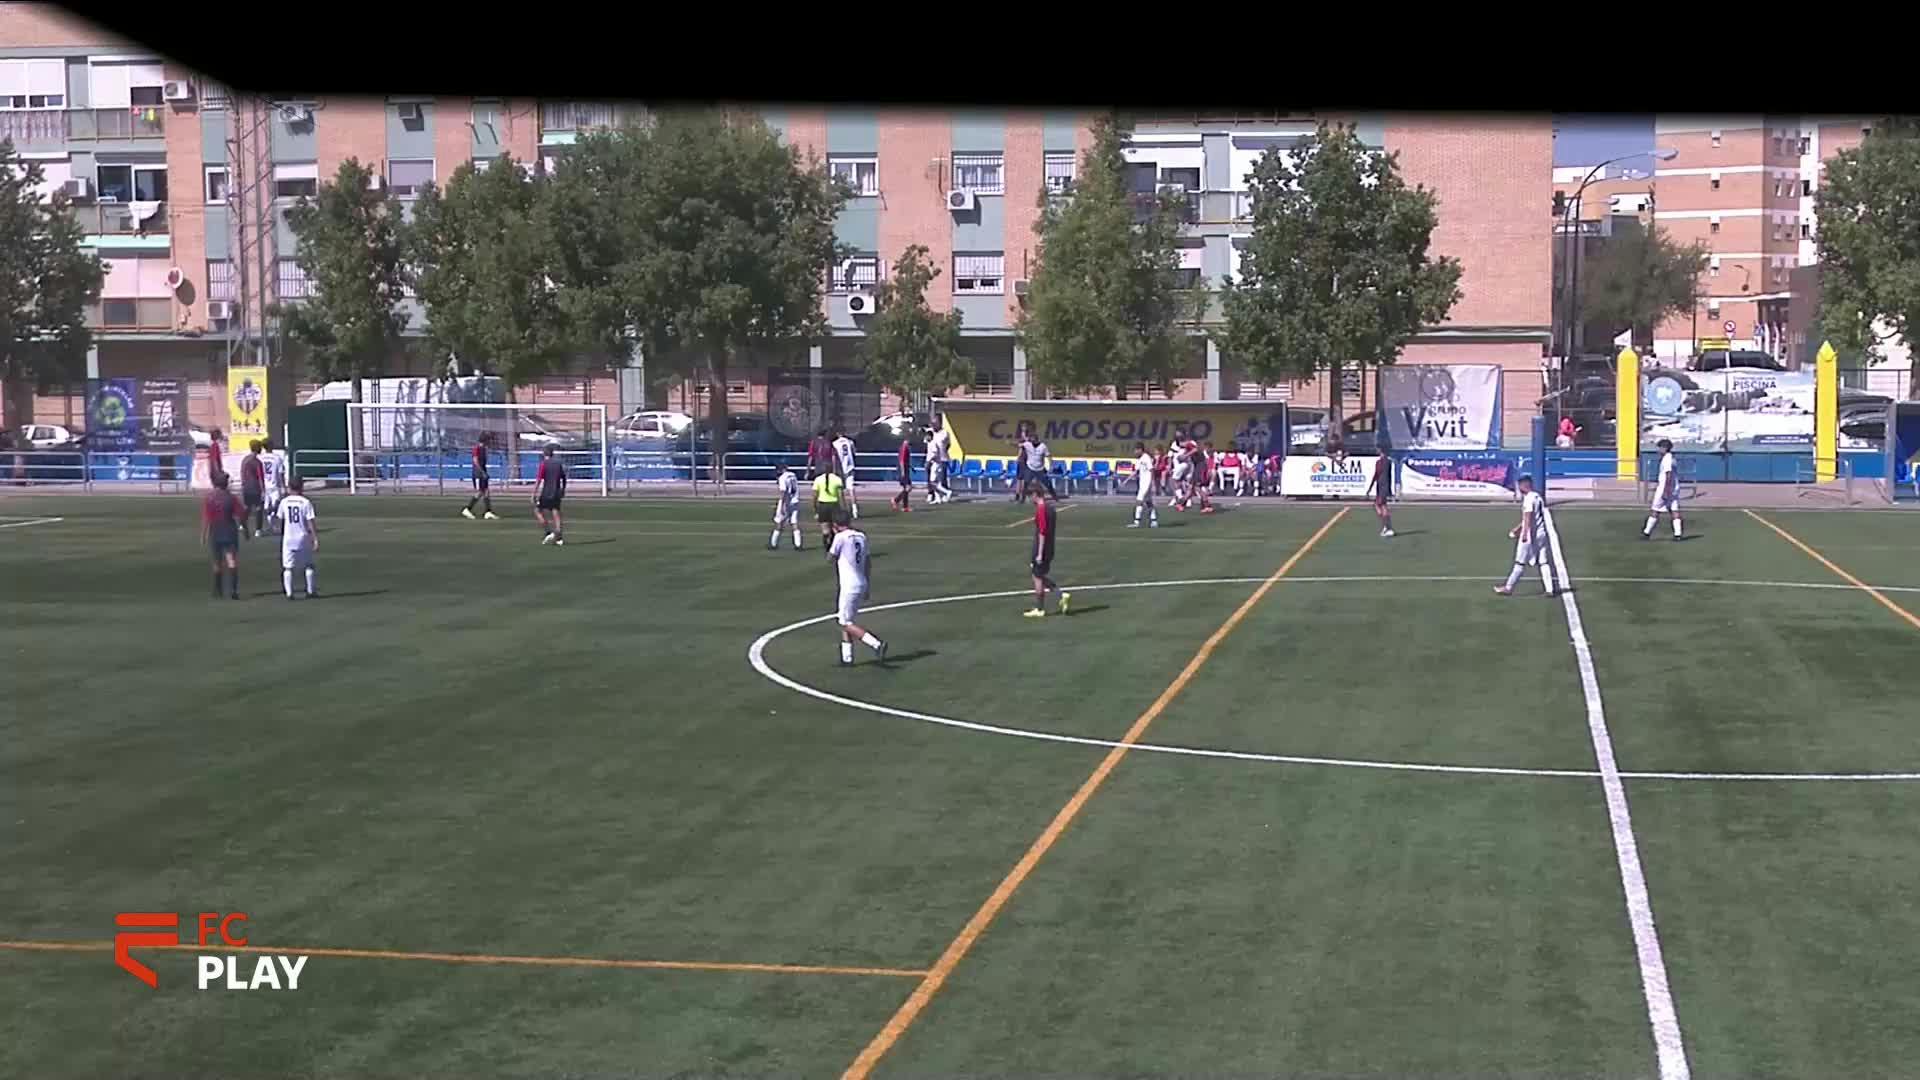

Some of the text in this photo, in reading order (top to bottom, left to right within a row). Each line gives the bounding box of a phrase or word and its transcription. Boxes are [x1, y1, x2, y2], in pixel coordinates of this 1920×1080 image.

[1732, 380, 1776, 390] PISCINA
[1044, 418, 1213, 440] MOSQUITO
[288, 506, 300, 523] 18
